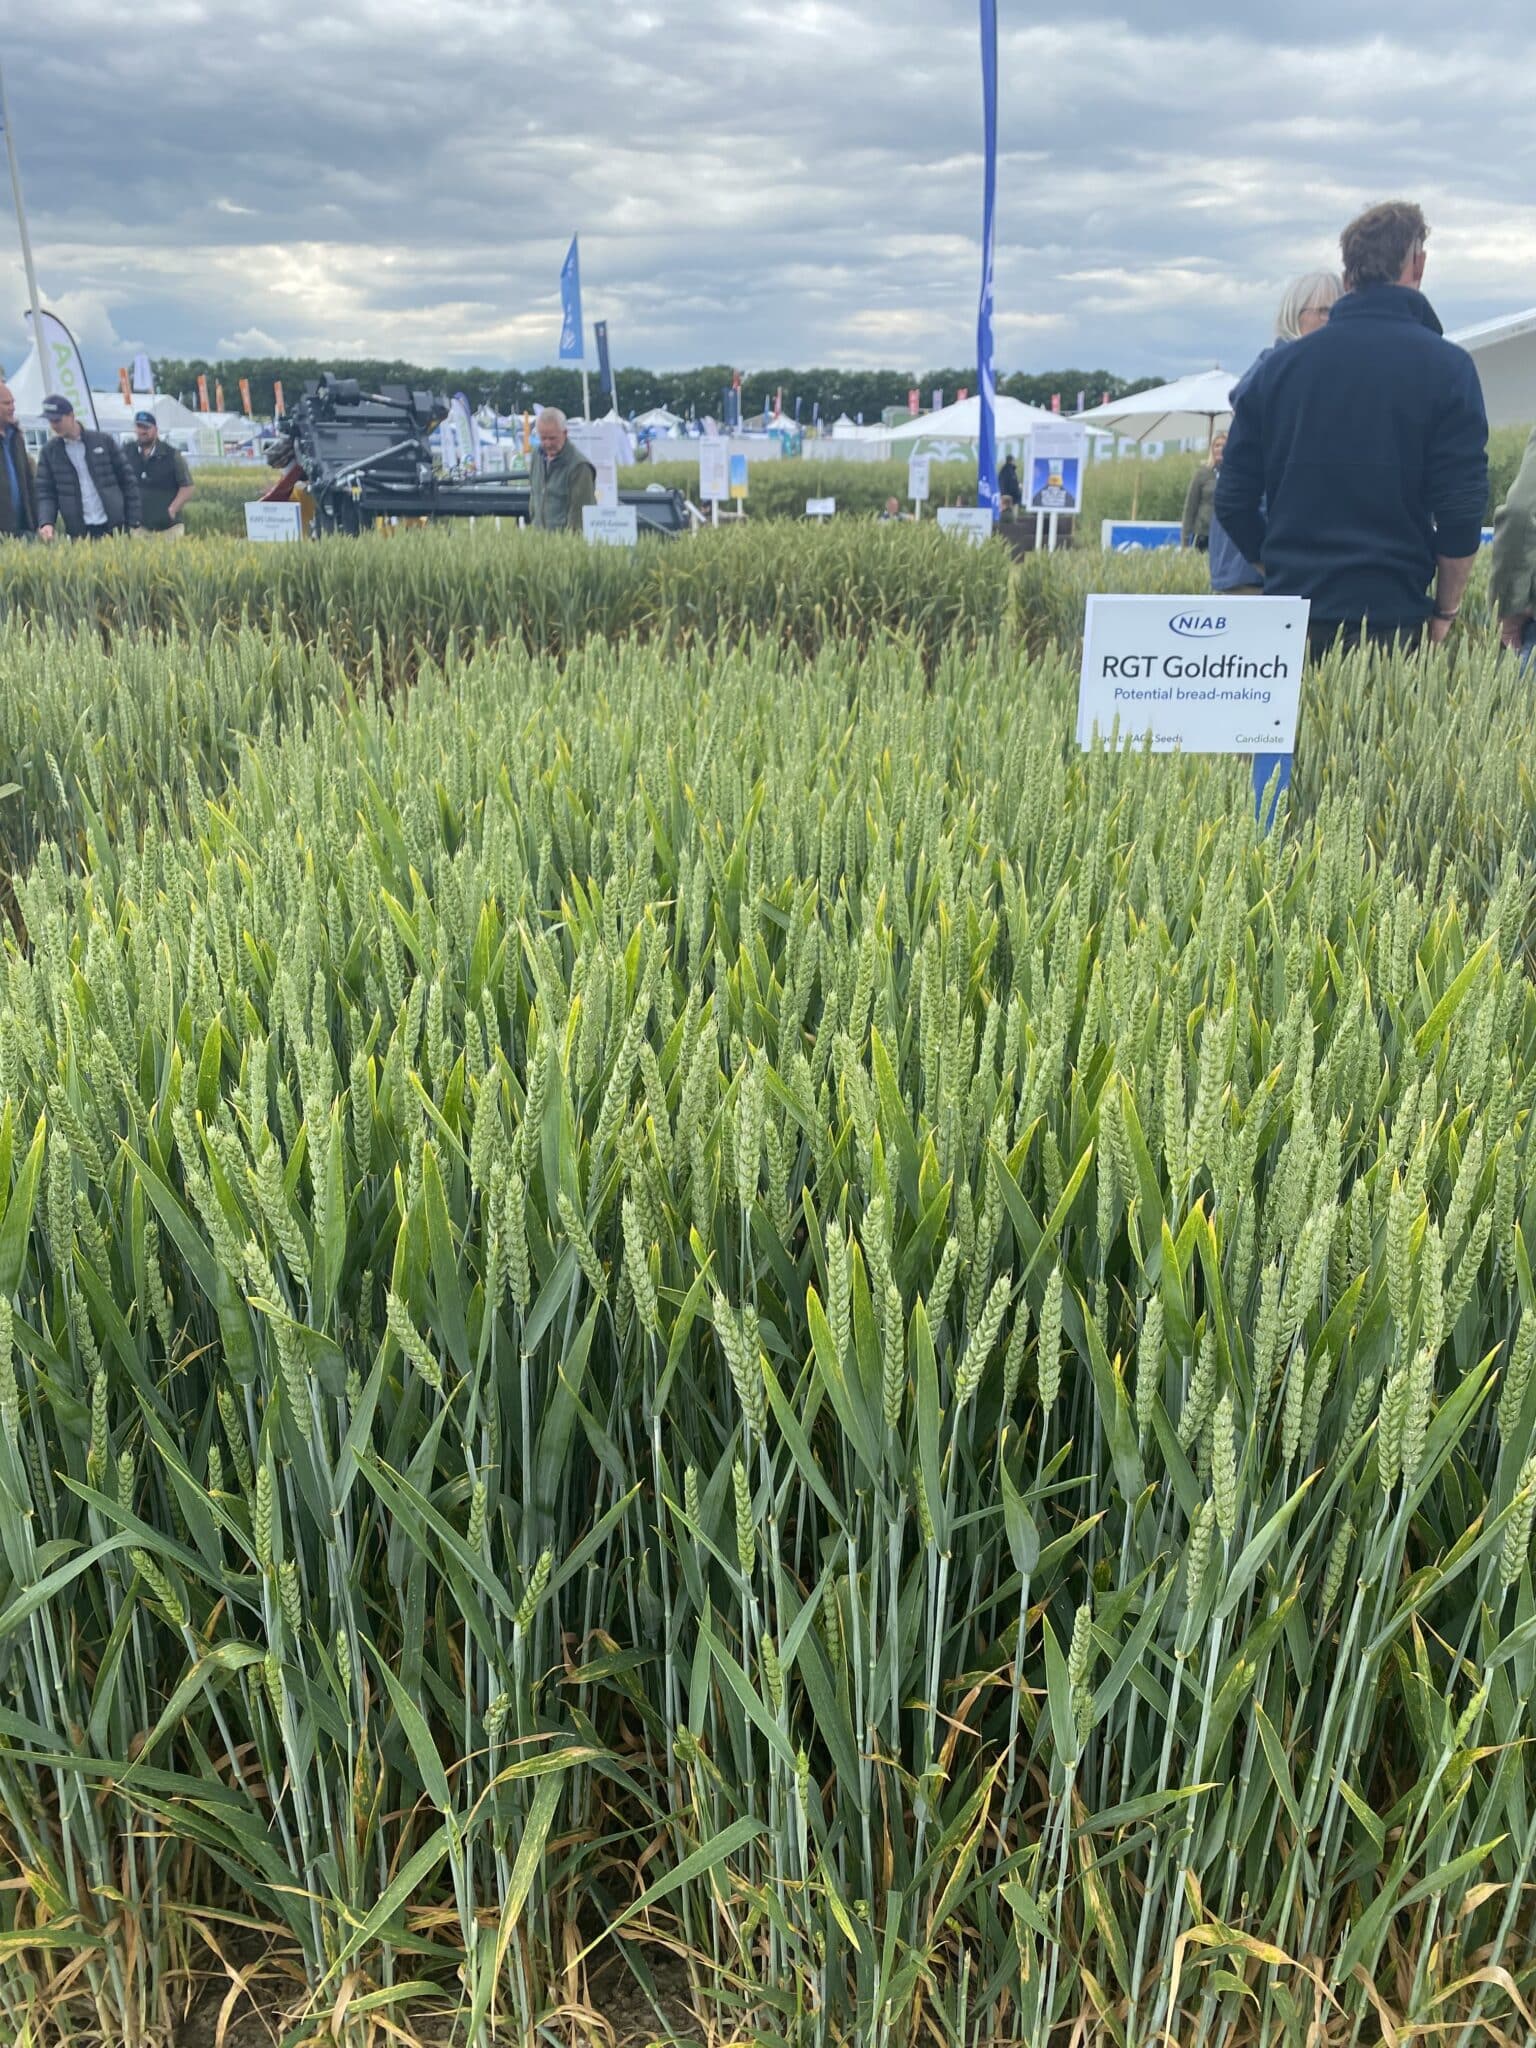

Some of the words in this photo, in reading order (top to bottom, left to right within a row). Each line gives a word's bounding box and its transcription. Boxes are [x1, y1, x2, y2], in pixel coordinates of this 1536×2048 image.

[1178, 616, 1227, 630] NIAB
[1102, 655, 1158, 678] RGT
[1163, 654, 1288, 679] Goldfinch
[1114, 687, 1173, 701] Potential
[1176, 687, 1272, 704] bread-making
[1154, 734, 1184, 744] Seeds
[1235, 734, 1285, 744] Candidate
